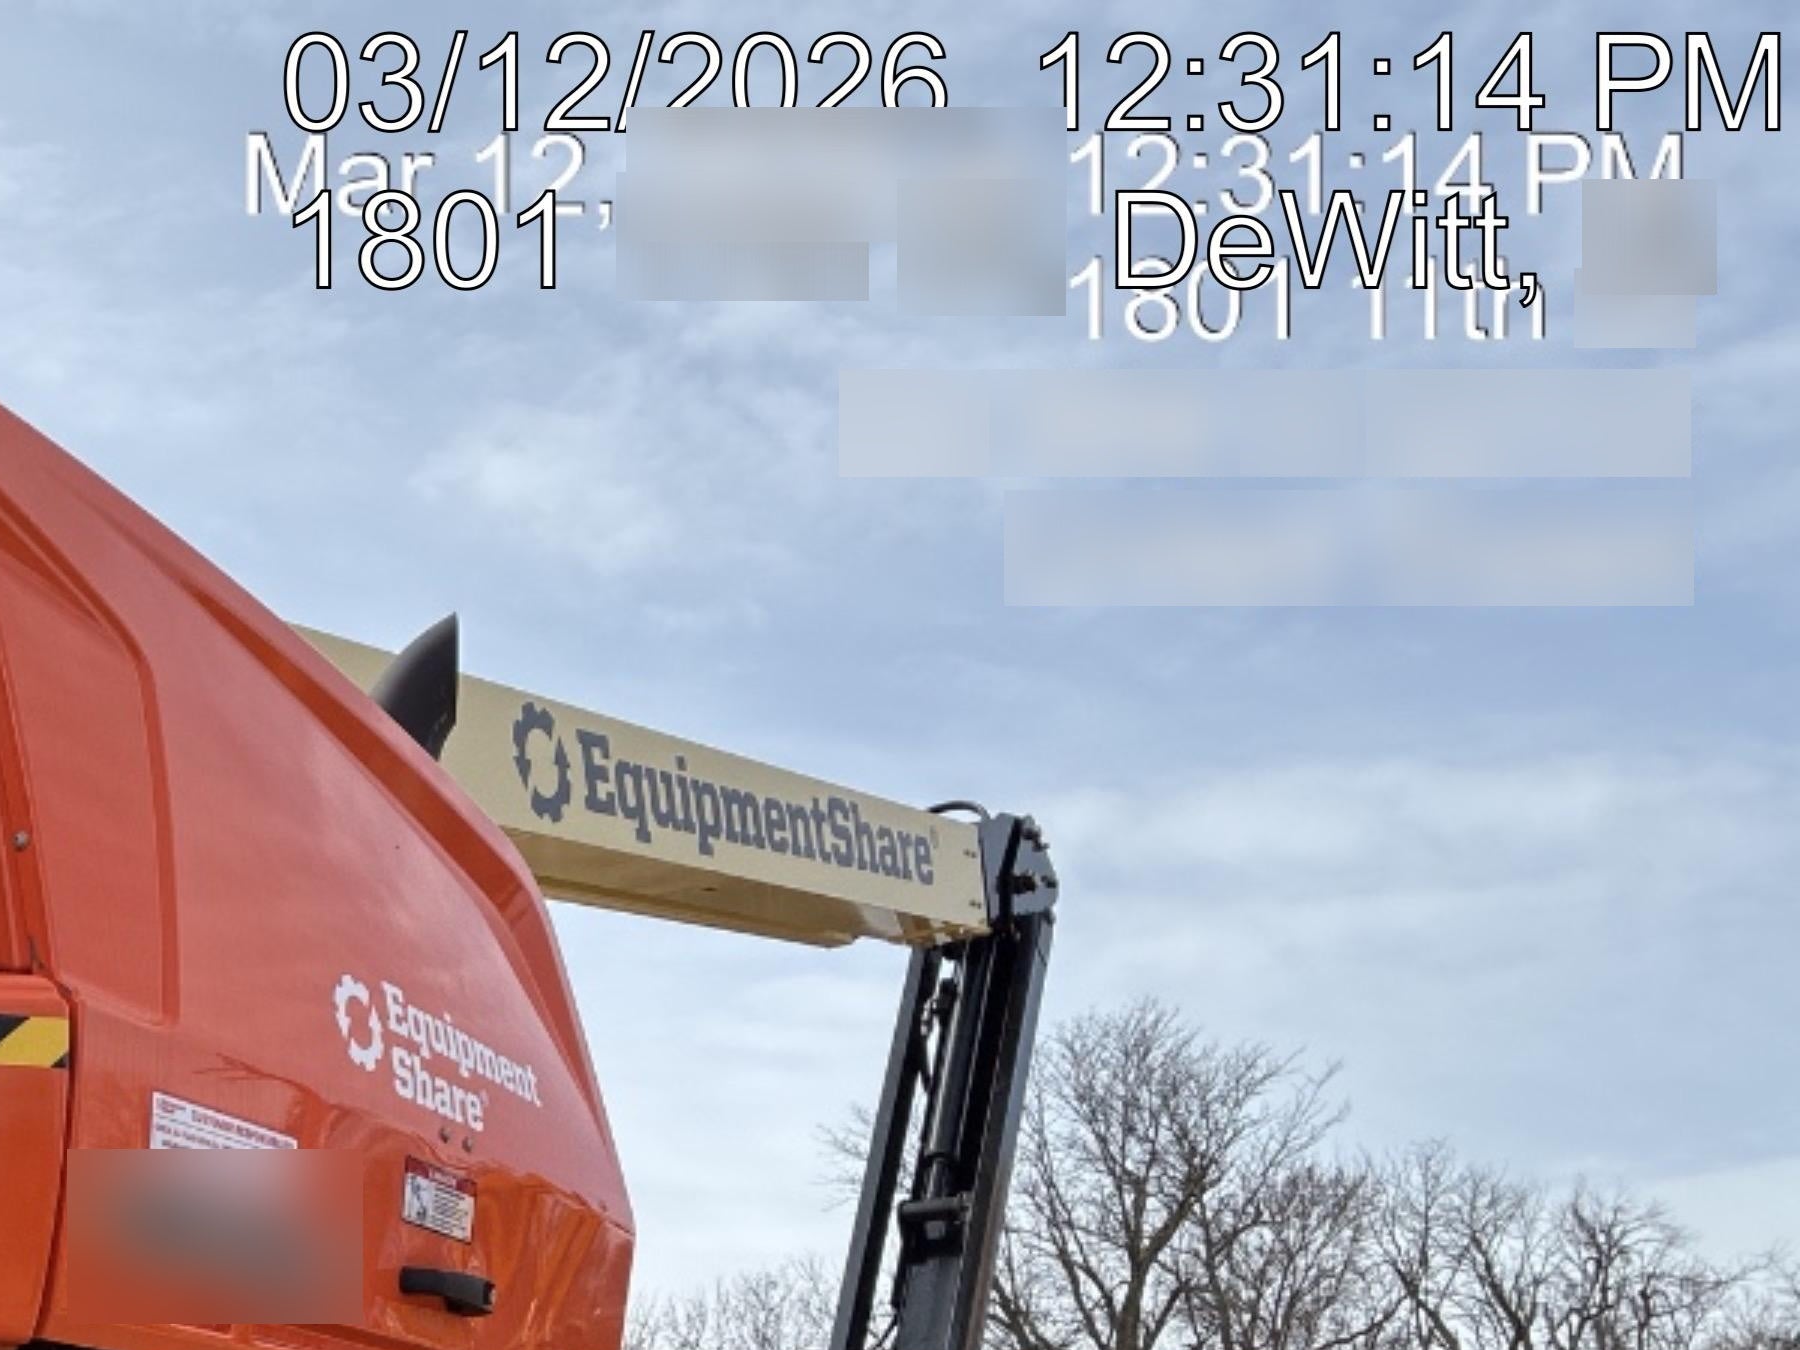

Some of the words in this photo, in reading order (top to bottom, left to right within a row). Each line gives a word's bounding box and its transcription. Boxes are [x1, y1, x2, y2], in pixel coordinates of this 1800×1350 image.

[575, 727, 935, 886] EquipmentShare
[381, 980, 542, 1108] Equipment
[392, 1045, 485, 1132] Share
